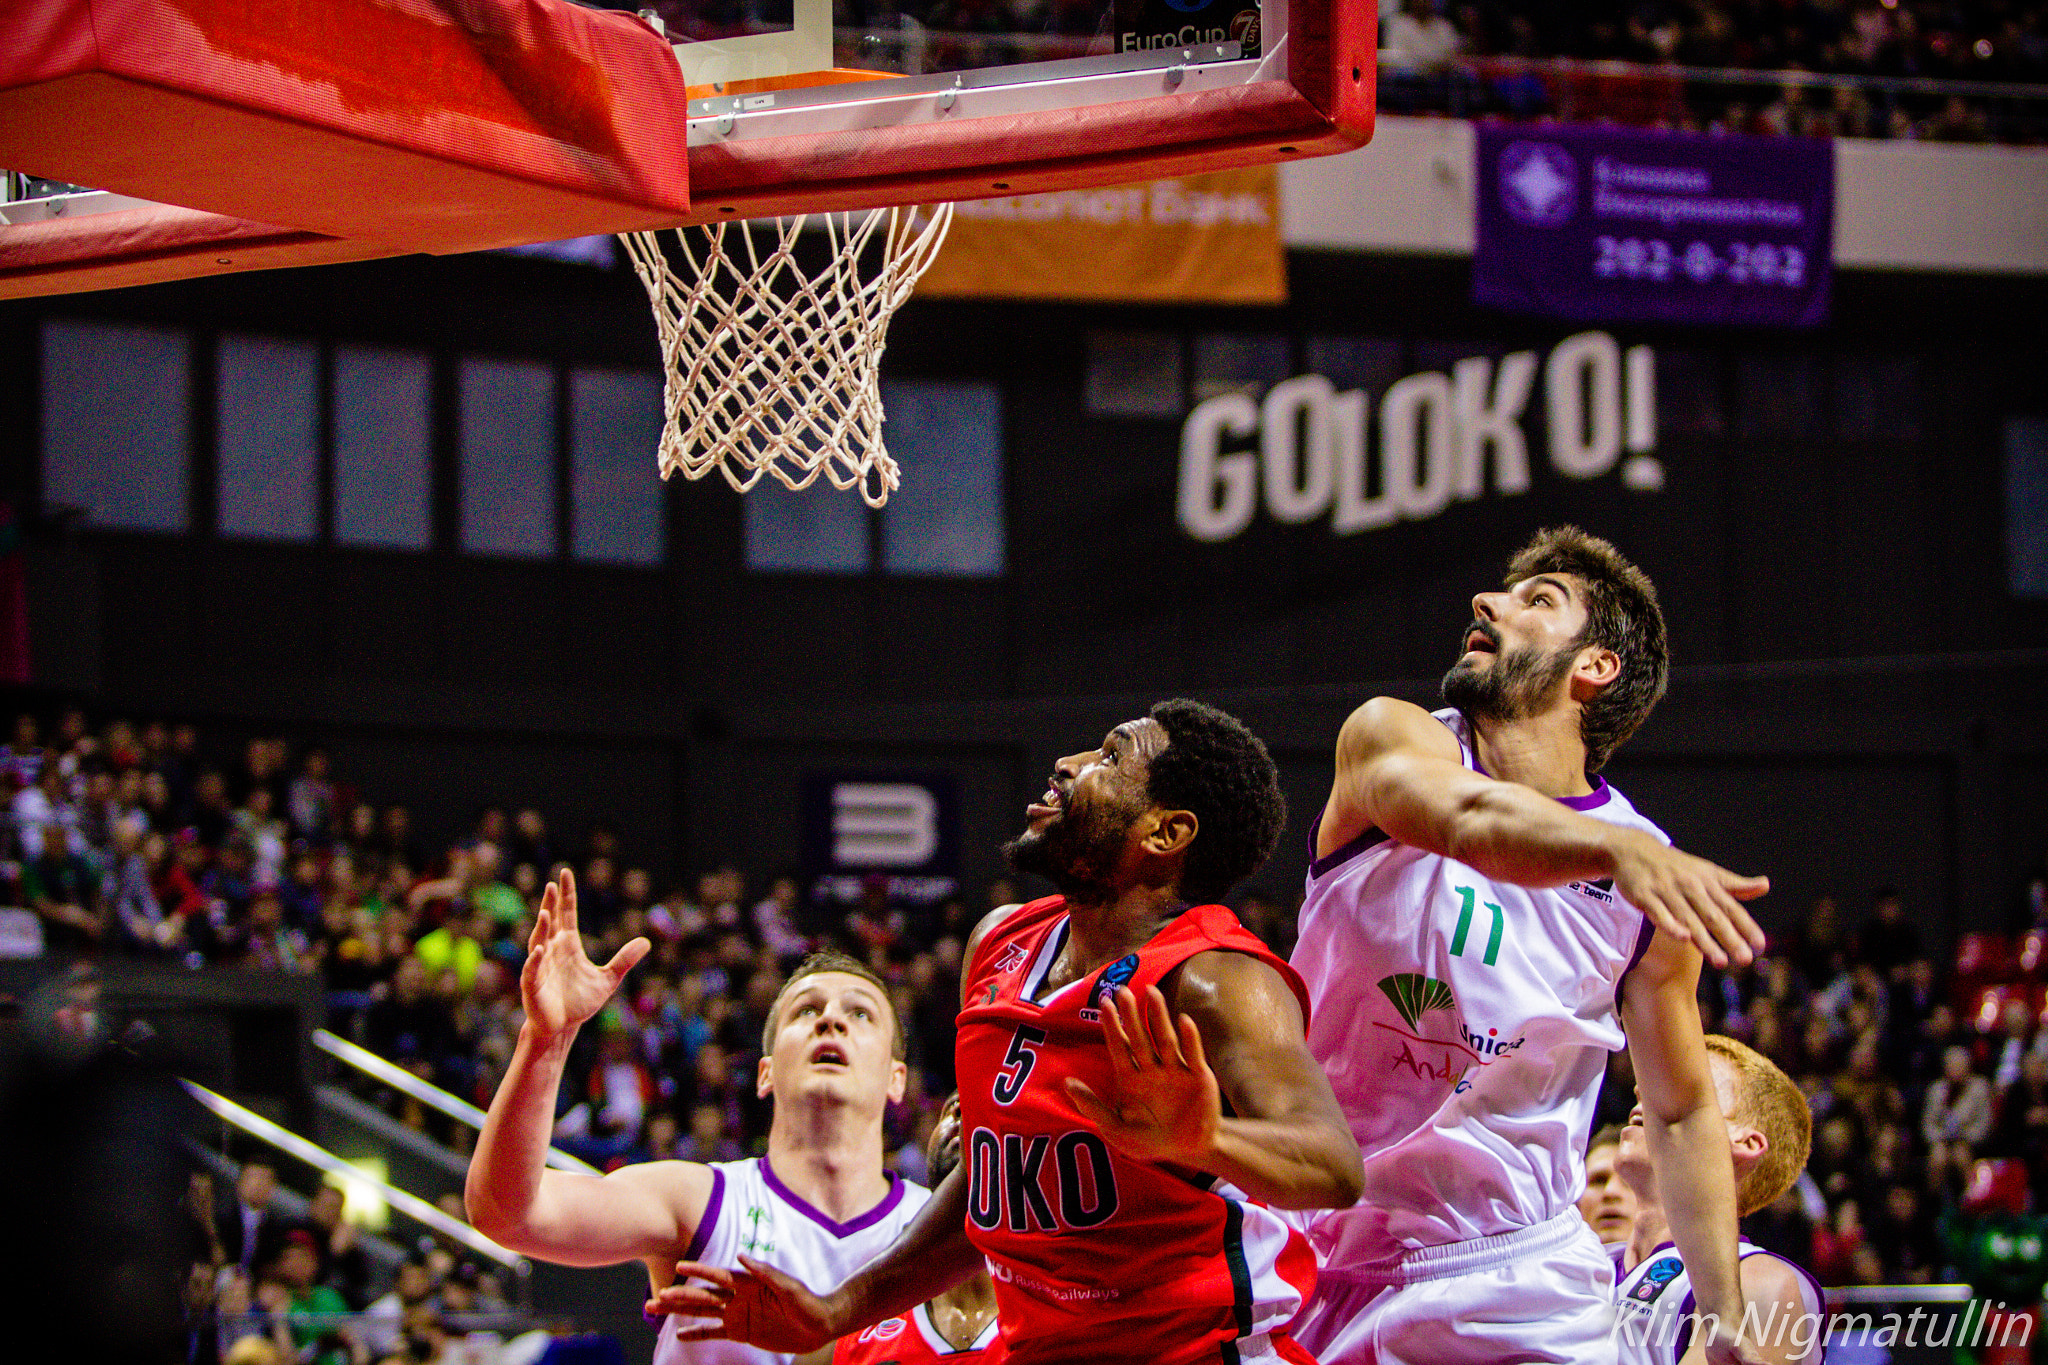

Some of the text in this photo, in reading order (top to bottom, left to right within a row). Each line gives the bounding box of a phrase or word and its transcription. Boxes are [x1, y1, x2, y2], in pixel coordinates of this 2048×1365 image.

[1122, 25, 1225, 52] EuroCup
[1449, 884, 1505, 967] 11
[992, 1022, 1049, 1105] 5
